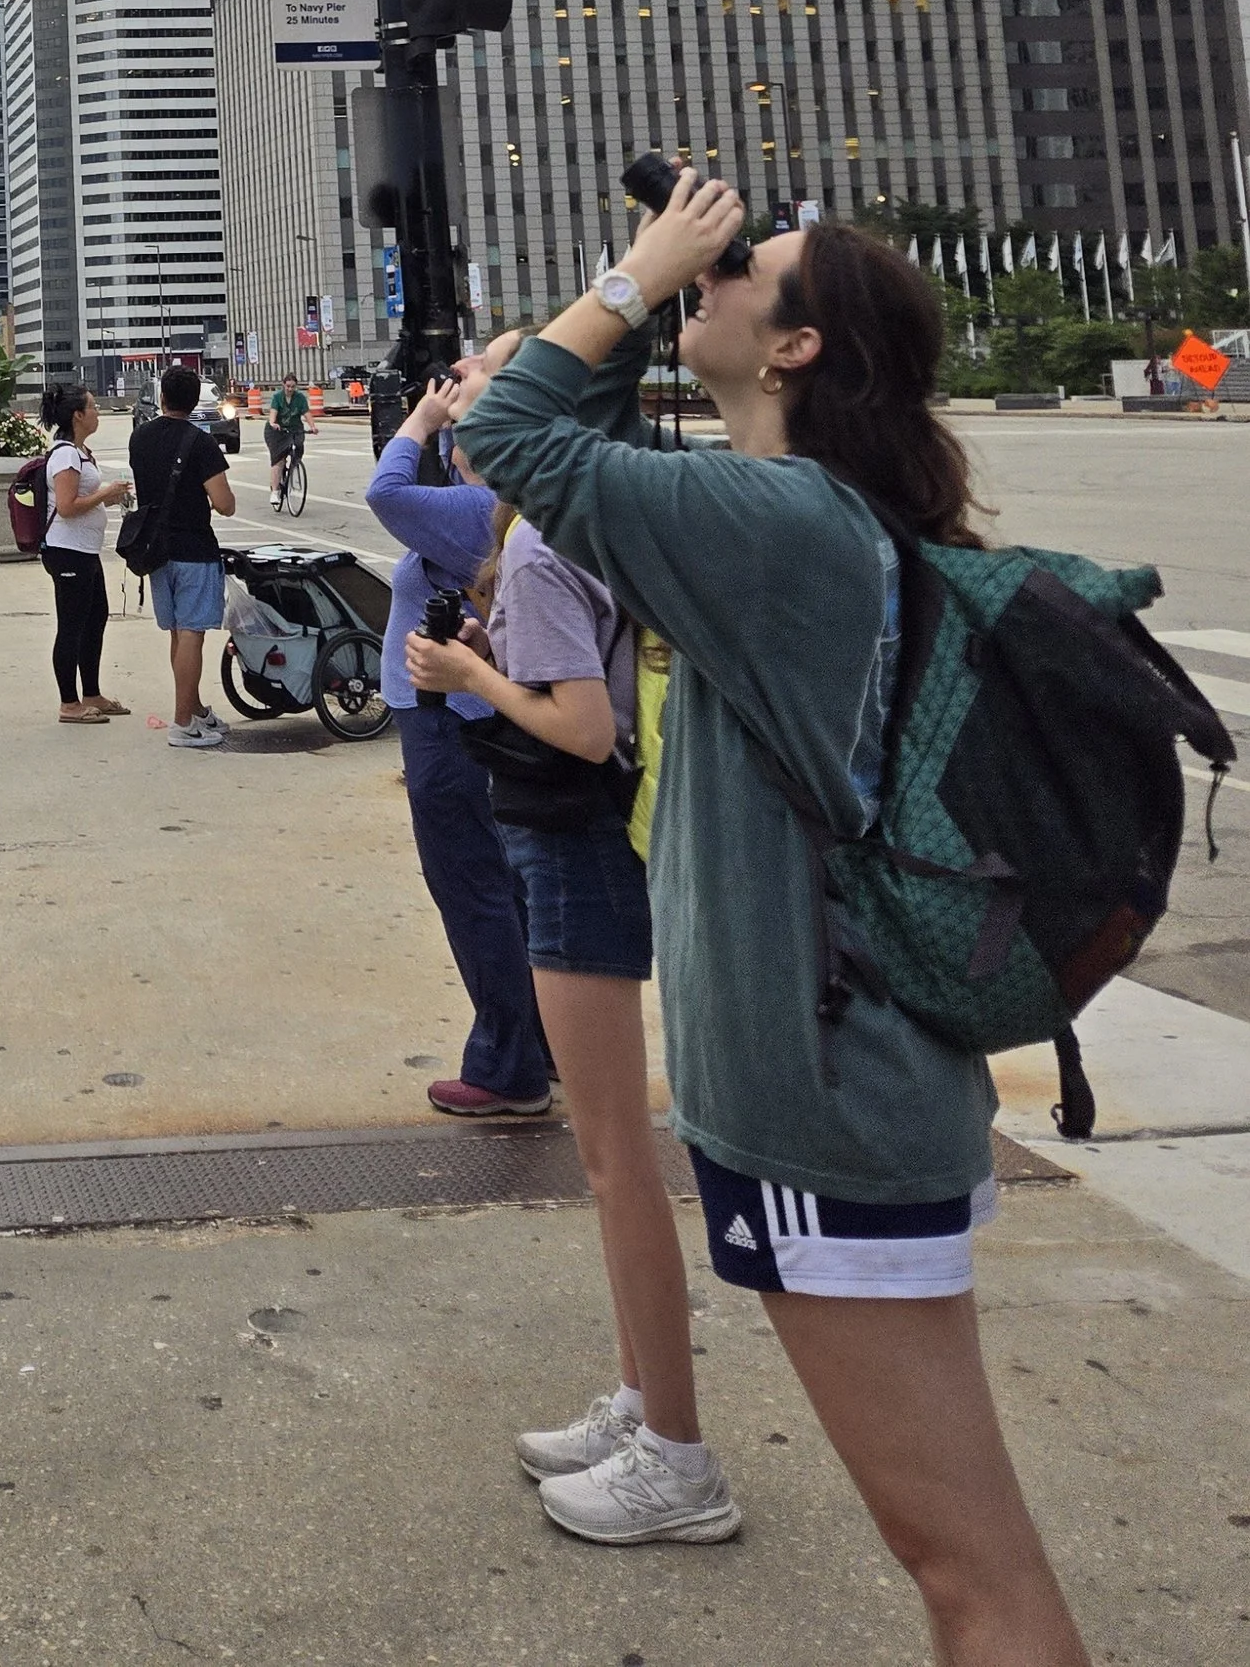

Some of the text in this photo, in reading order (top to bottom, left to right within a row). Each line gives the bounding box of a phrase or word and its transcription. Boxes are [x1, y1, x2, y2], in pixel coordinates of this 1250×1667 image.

[286, 3, 346, 14] To Navy Pier
[286, 16, 339, 25] 25 Minutes
[724, 1233, 758, 1251] adidas
